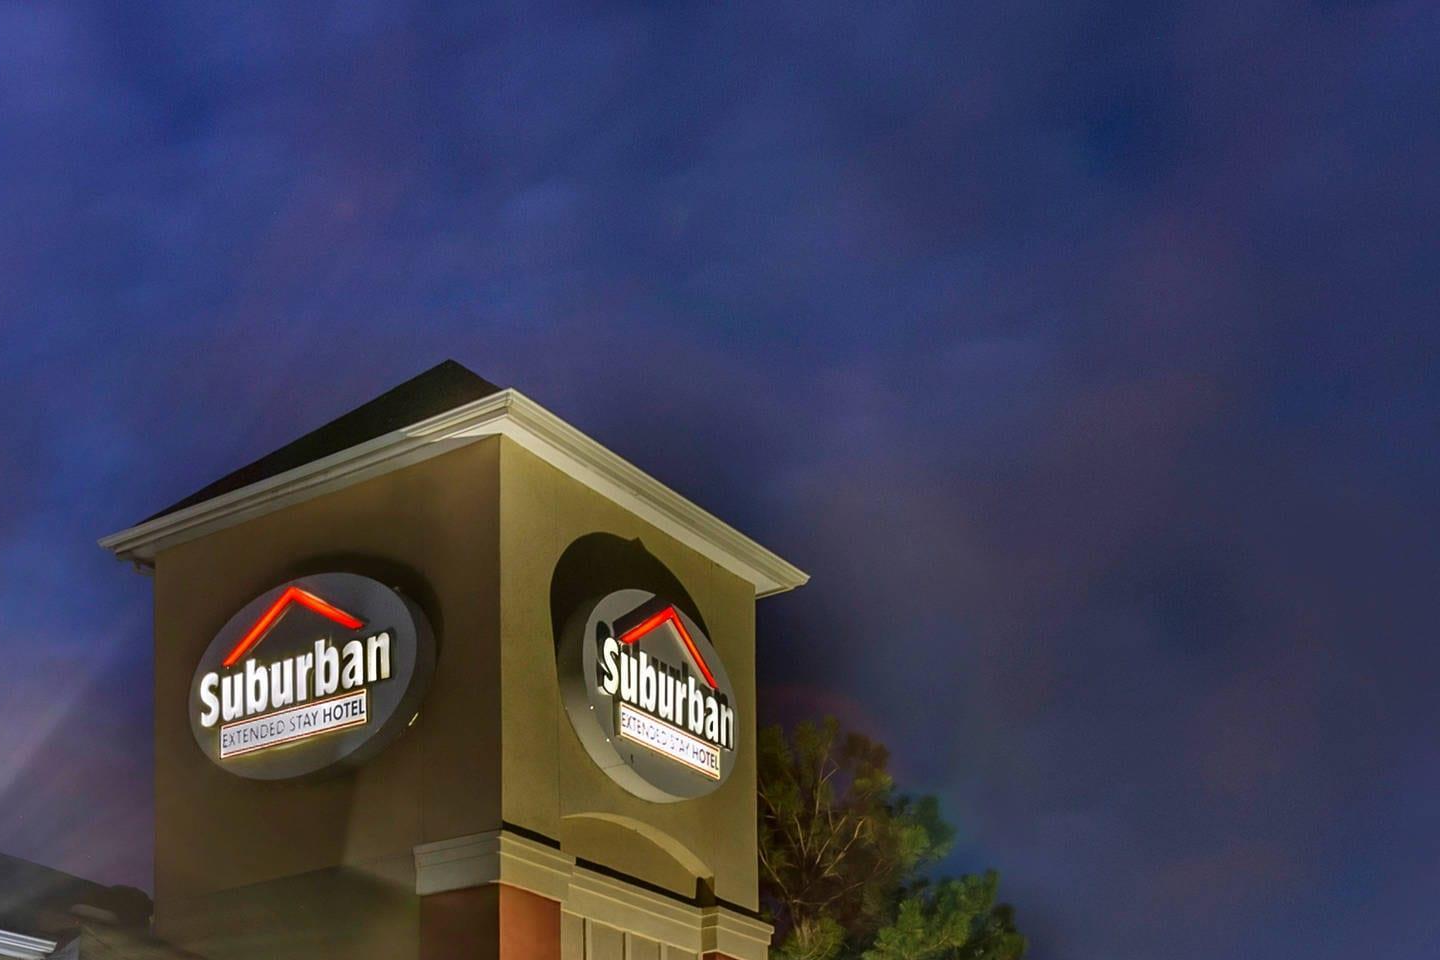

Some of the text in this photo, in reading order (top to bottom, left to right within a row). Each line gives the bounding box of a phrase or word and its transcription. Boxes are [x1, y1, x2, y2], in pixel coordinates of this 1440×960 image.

[200, 631, 391, 728] Suburban
[603, 637, 735, 750] Suburban
[222, 698, 365, 748] EXTENDED STAY HOTEL
[691, 744, 719, 771] HOTEL
